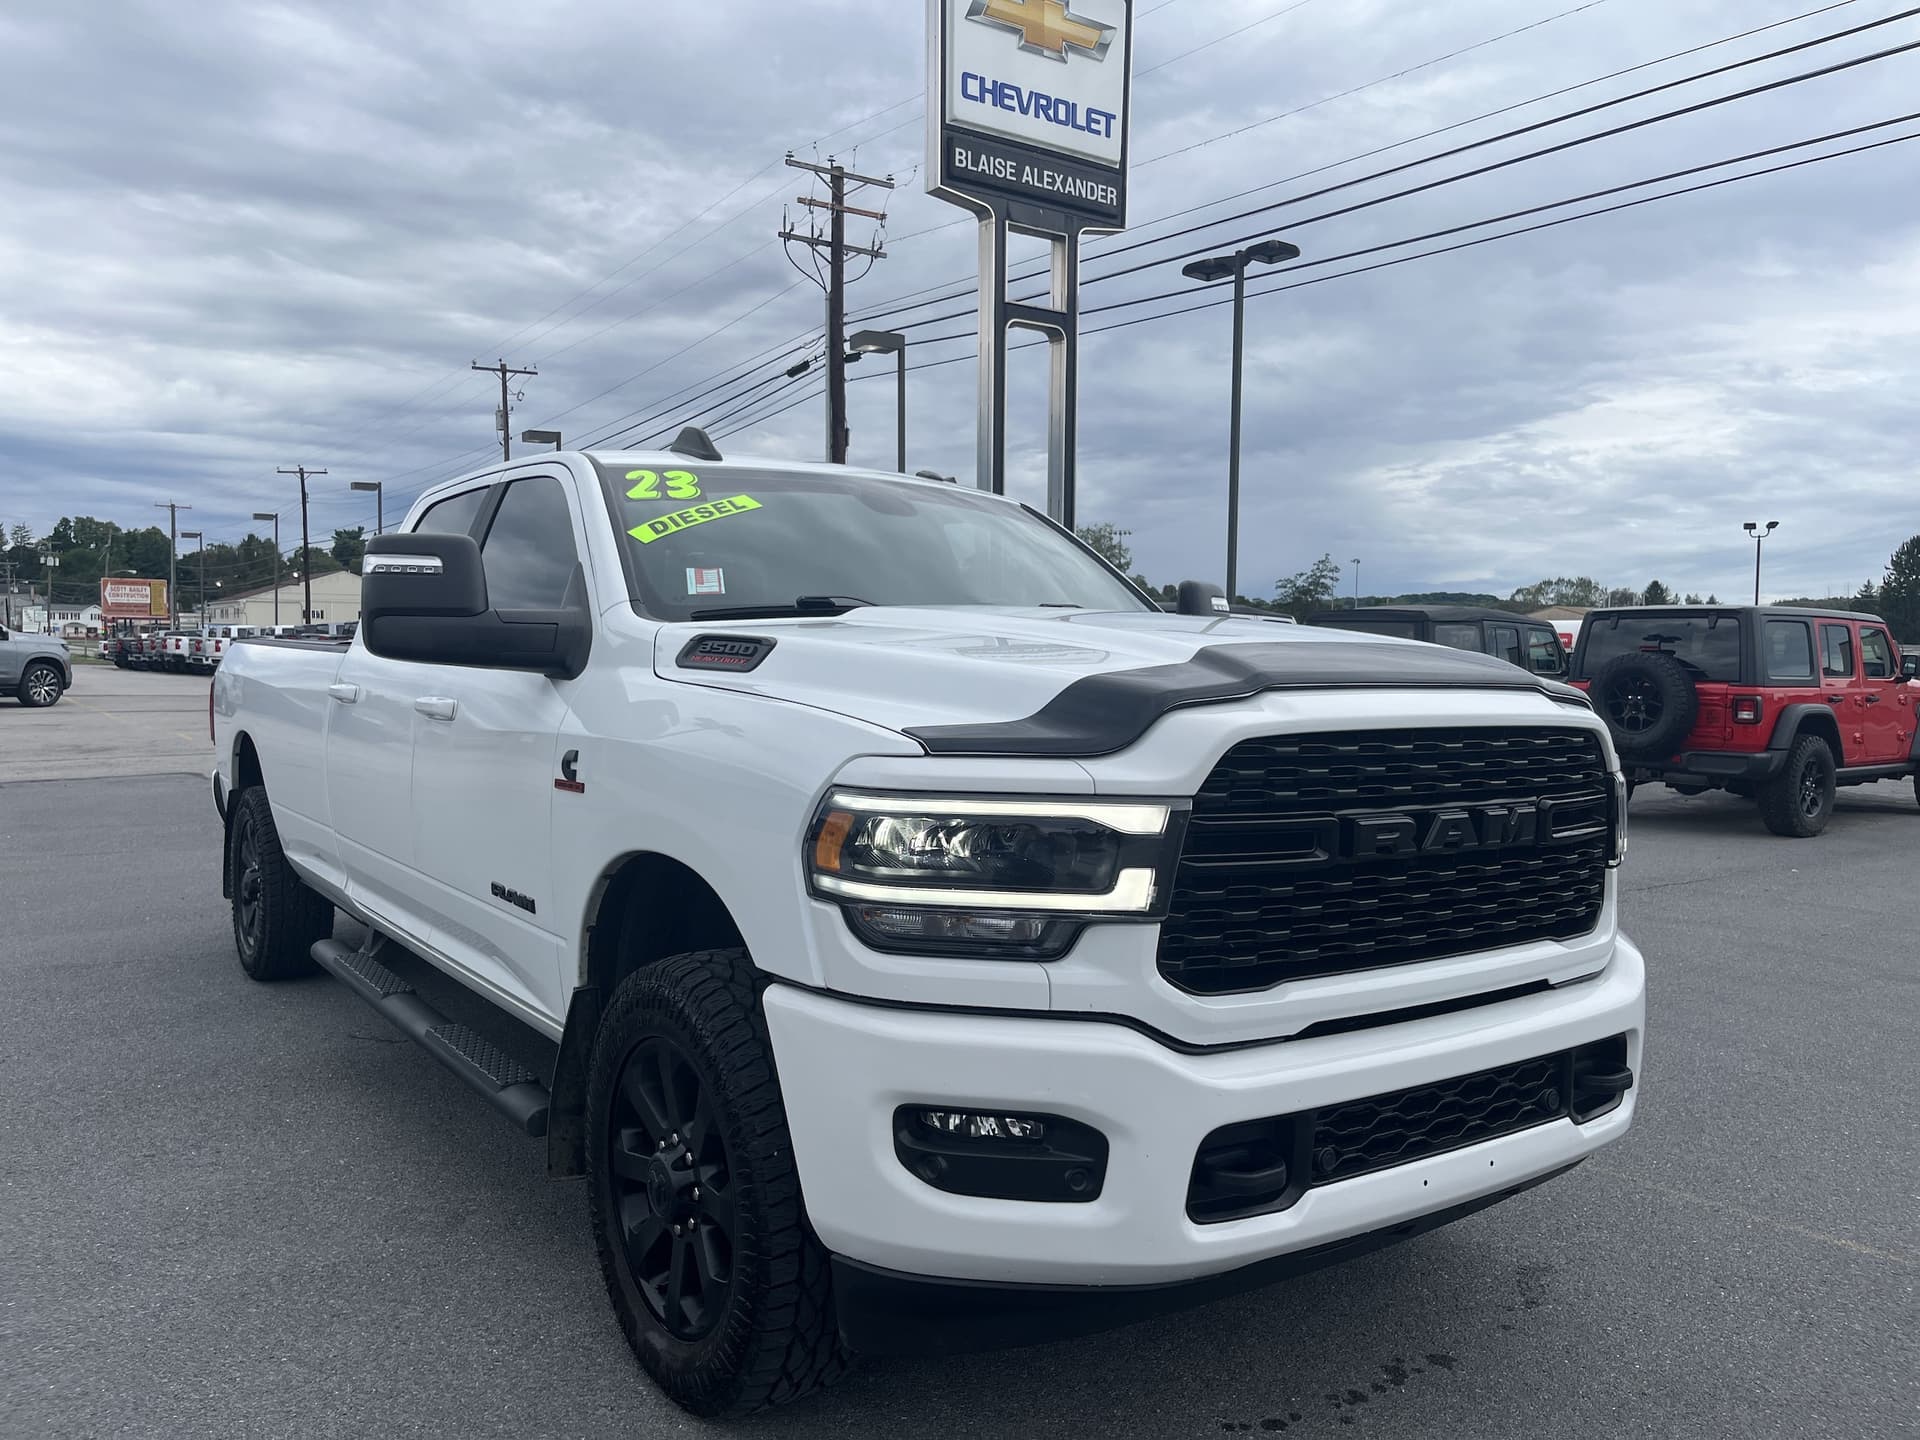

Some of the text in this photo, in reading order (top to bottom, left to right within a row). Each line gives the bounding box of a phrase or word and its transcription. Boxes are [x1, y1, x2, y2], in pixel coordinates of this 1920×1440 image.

[961, 71, 1116, 138] CHEVROLET
[955, 148, 1117, 206] BLAISE ALEXANDER
[625, 469, 701, 500] 23
[648, 499, 747, 535] DIESEL
[698, 640, 755, 655] 3500
[1354, 805, 1537, 855] RAM
